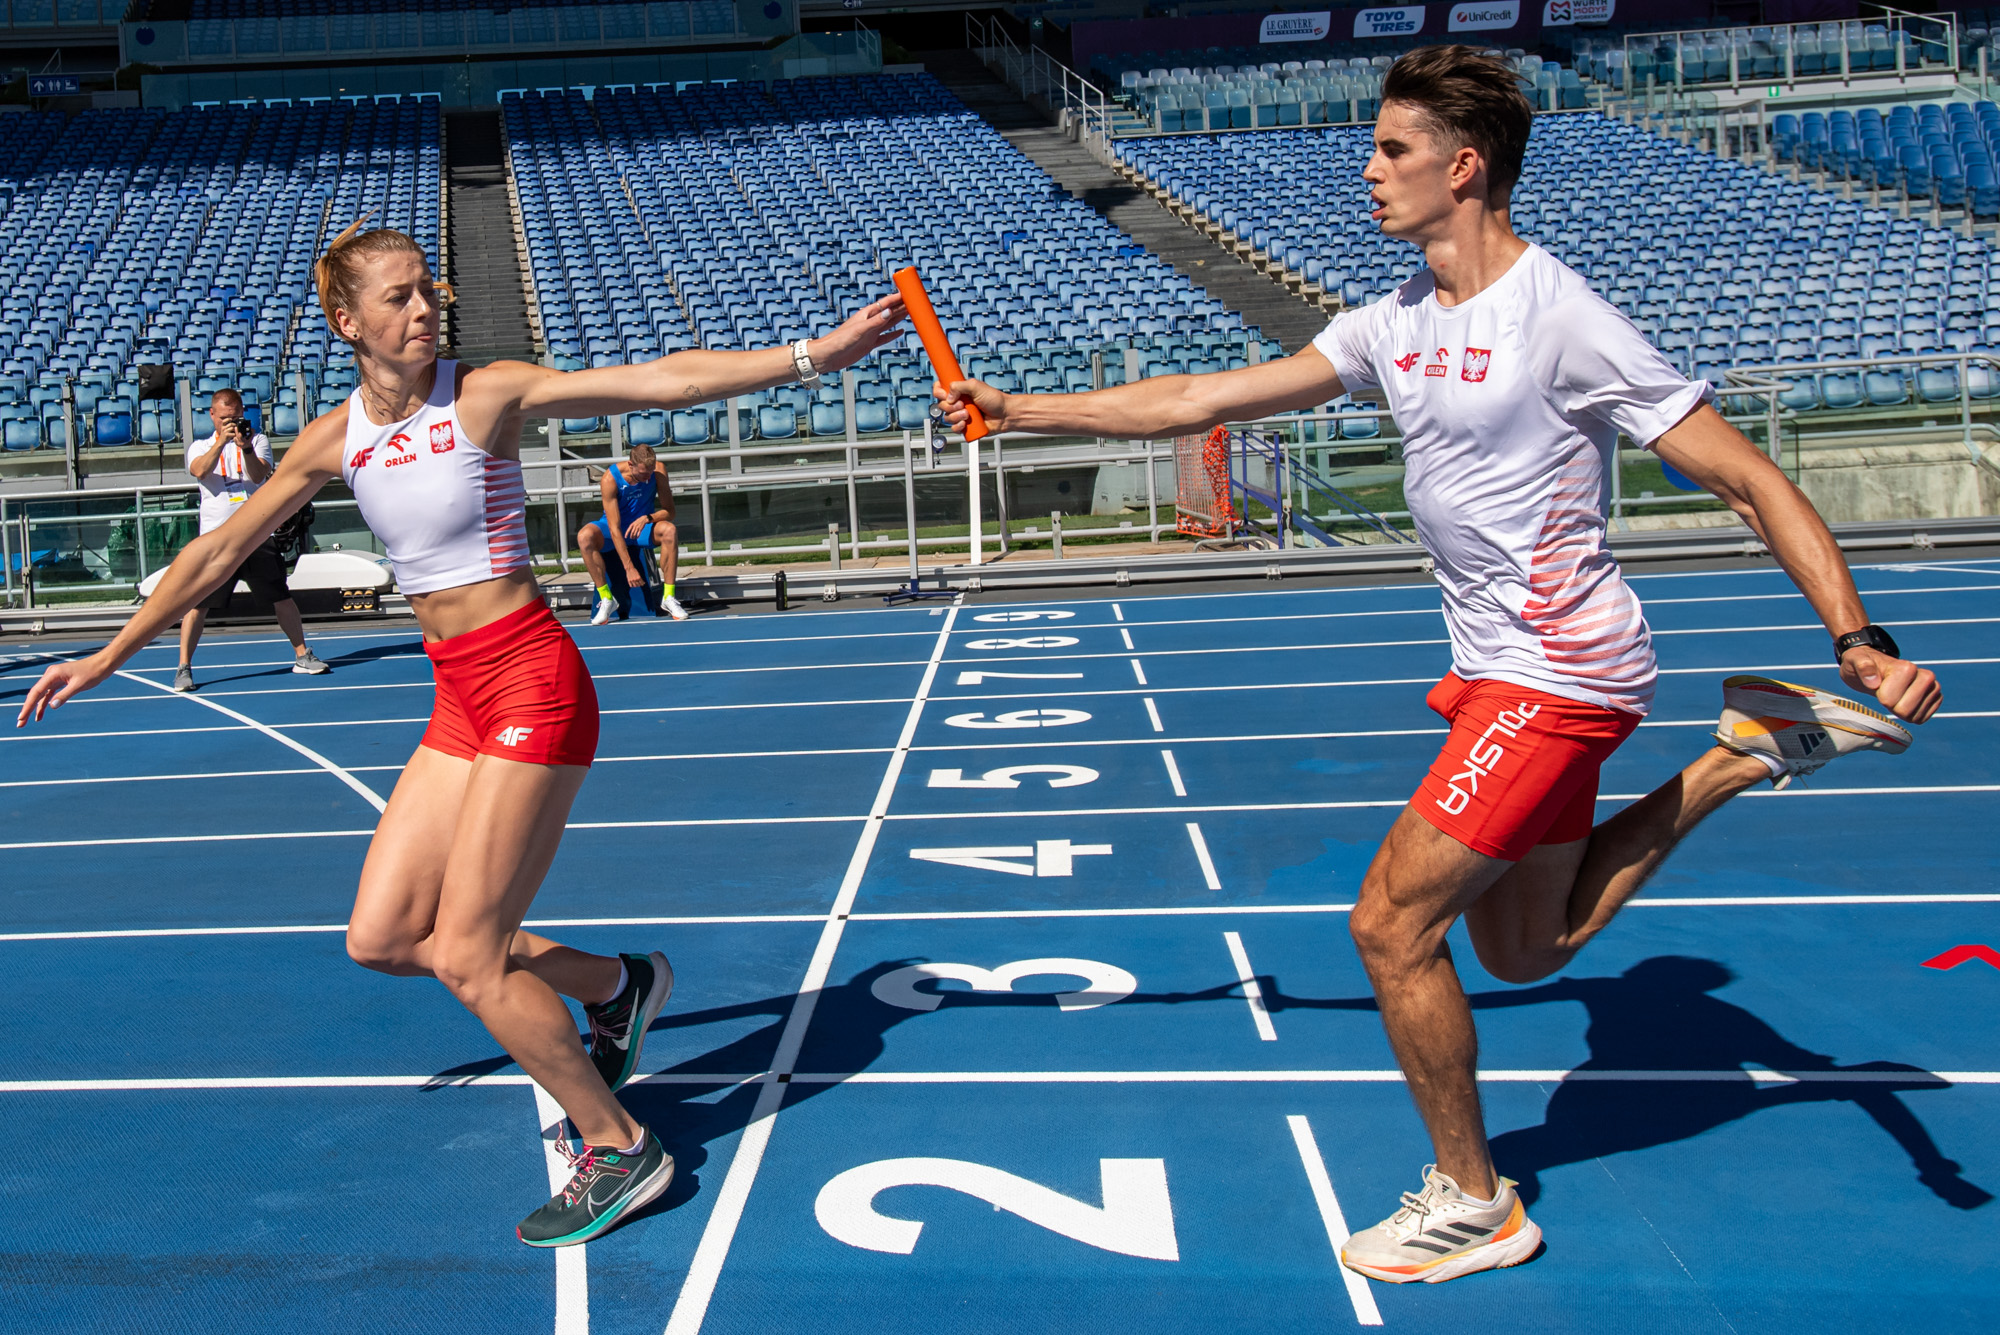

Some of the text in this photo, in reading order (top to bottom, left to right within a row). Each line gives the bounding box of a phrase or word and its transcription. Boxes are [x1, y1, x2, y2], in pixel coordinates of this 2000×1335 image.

[1365, 11, 1404, 22] TOYO
[1468, 10, 1512, 22] UniCredit
[1573, 6, 1607, 14] MODYF
[1266, 20, 1277, 30] LE
[1372, 21, 1415, 33] TIRES
[350, 446, 375, 468] 4F
[385, 453, 417, 467] ORLEN
[974, 610, 1075, 622] 9
[965, 636, 1079, 649] 8
[957, 671, 1084, 685] 7
[944, 708, 1092, 729] 6
[495, 726, 534, 747] 4F
[927, 764, 1100, 789] 5
[909, 839, 1113, 877] 4
[871, 957, 1137, 1012] 3
[815, 1157, 1180, 1262] 2
